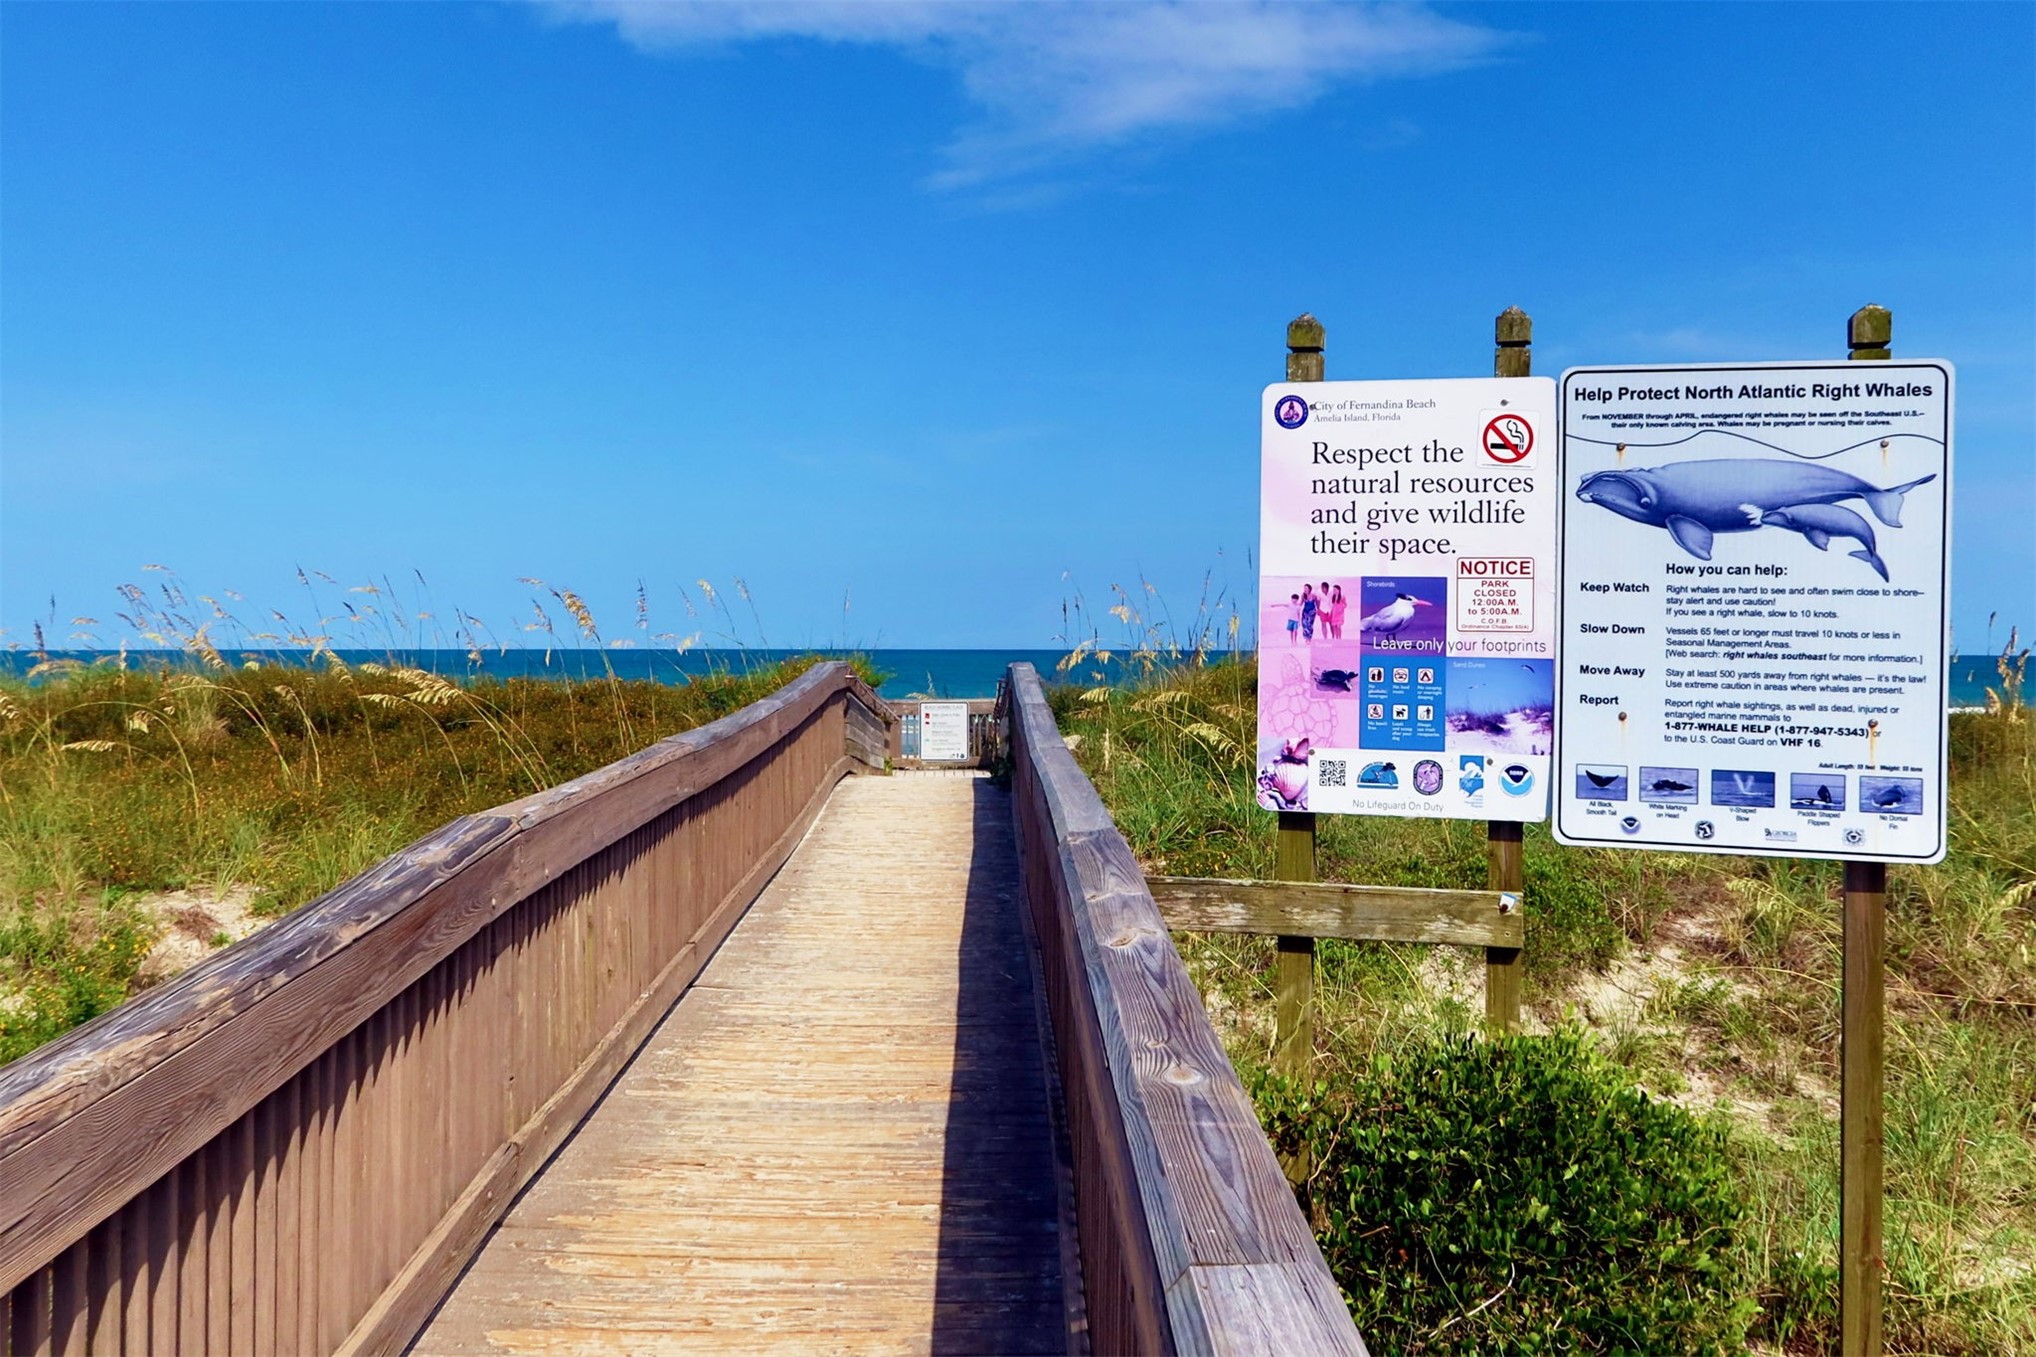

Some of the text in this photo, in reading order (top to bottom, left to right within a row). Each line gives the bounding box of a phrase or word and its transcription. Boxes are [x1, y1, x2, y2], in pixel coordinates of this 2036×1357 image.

[1575, 383, 1933, 404] Help Protect North Atlantic Right Whales
[1314, 399, 1436, 411] City of Fernandina Beach
[1314, 414, 1342, 422] Amelia
[1372, 413, 1401, 421] Florida
[1312, 439, 1463, 469] Respect the
[1312, 471, 1534, 494] natural resources
[1312, 500, 1525, 531] and give wildlife
[1311, 531, 1456, 561] their space.
[1460, 560, 1531, 575] NOTICE
[1666, 563, 1787, 578] How you can help:
[1481, 580, 1509, 588] PARK
[1581, 582, 1649, 594] Keep Watch
[1474, 589, 1517, 597] CLOSED
[1666, 585, 1688, 595] Right
[1690, 586, 1720, 594] whales
[1738, 586, 1758, 594] hard
[1760, 587, 1768, 595] to
[1789, 587, 1805, 595] and
[1807, 587, 1829, 595] often
[1856, 588, 1880, 596] close
[1666, 597, 1684, 606] stay
[1686, 597, 1704, 605] alert
[1706, 597, 1722, 605] and
[1742, 598, 1776, 606] caution!
[1666, 607, 1672, 615] If
[1674, 609, 1689, 617] you
[1717, 609, 1735, 618] right
[1737, 609, 1765, 618] whale,
[1789, 610, 1798, 618] to
[1801, 610, 1811, 618] 10
[1580, 624, 1645, 634] Slow Down
[1666, 627, 1698, 635] Vessels
[1700, 627, 1711, 636] 65
[1713, 628, 1730, 636] feet
[1743, 629, 1770, 638] longer
[1795, 630, 1819, 638] travel
[1822, 630, 1833, 638] 10
[1835, 631, 1859, 639] knots
[1872, 631, 1890, 639] less
[1373, 637, 1546, 655] Leave only your footprints
[1666, 638, 1791, 649] Seasonal Management Areas.
[1666, 649, 1687, 659] [Web
[1723, 651, 1745, 661] right
[1747, 651, 1778, 660] whales
[1781, 653, 1827, 661] southeast
[1829, 653, 1841, 661] for
[1580, 665, 1645, 678] Move Away
[1666, 668, 1685, 678] Stay
[1697, 670, 1717, 678] least
[1720, 670, 1736, 678] 500
[1738, 671, 1761, 680] yards
[1763, 673, 1786, 681] away
[1788, 672, 1808, 680] from
[1810, 673, 1830, 682] right
[1832, 674, 1862, 682] whales
[1892, 675, 1906, 683] the
[1908, 675, 1926, 683] law!
[1666, 680, 1682, 688] Use
[1685, 681, 1718, 689] extreme
[1721, 682, 1752, 690] caution
[1790, 684, 1817, 692] where
[1819, 685, 1850, 693] whales
[1580, 694, 1619, 706] Report
[1665, 699, 1693, 708] Report
[1695, 700, 1714, 710] right
[1716, 701, 1741, 709] whale
[1743, 702, 1783, 712] sightings,
[1798, 703, 1816, 711] well
[1858, 706, 1888, 714] injured
[1665, 711, 1706, 721] entangled
[1739, 714, 1781, 722] mammals
[1665, 722, 1882, 739] 1-877-WHALE HELP (1-877-947-5343) or
[1675, 735, 1687, 743] the
[1711, 736, 1735, 744] Coast
[1738, 737, 1764, 746] Guard
[1780, 738, 1804, 747] VHF
[1353, 799, 1444, 813] No Lifeguard On Duty
